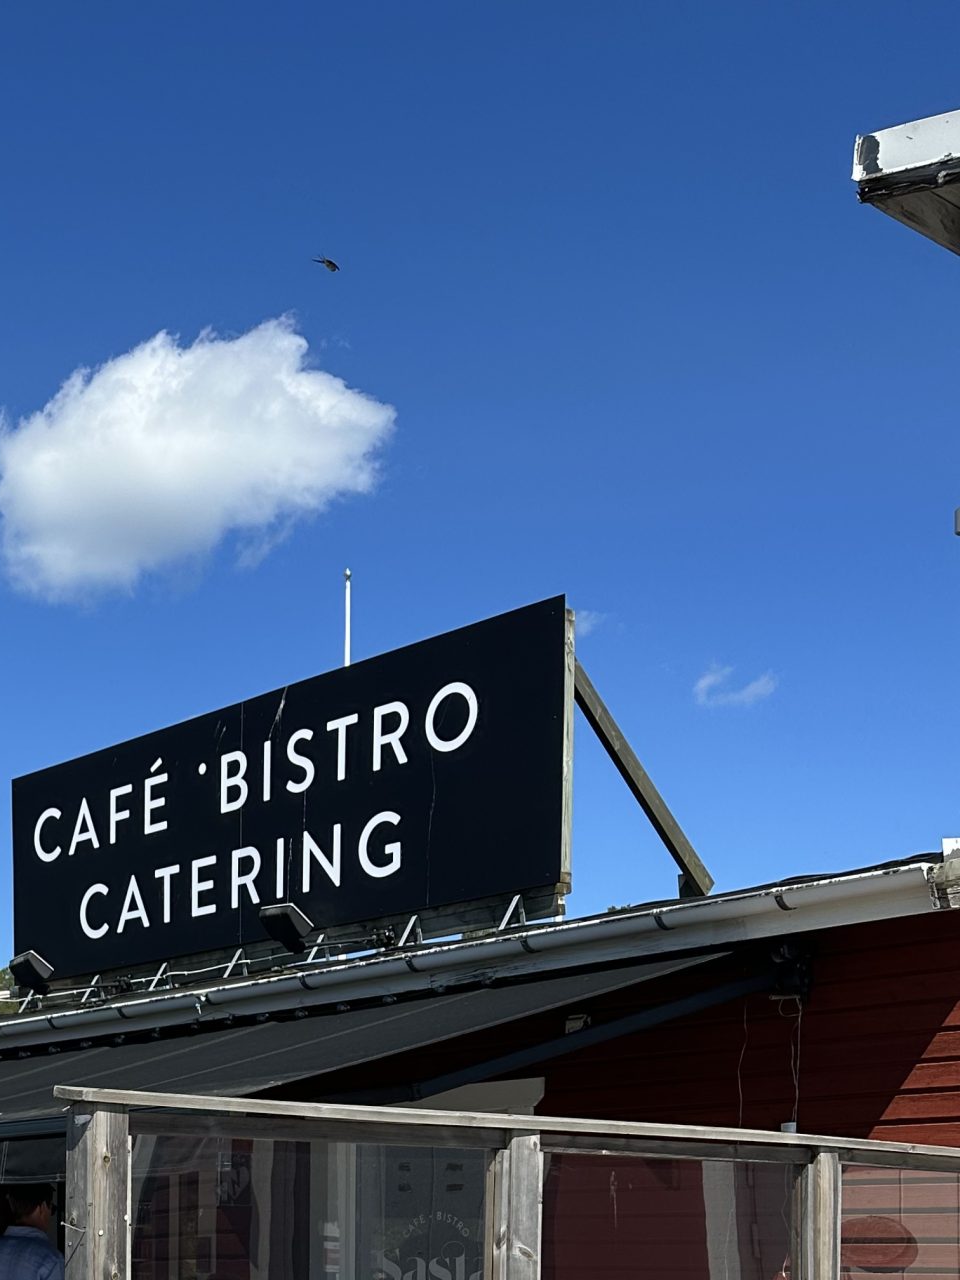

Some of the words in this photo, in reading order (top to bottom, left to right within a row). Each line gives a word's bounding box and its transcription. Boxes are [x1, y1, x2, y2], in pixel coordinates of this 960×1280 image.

[33, 757, 168, 863] CAFÉ
[220, 682, 479, 814] BISTRO
[79, 811, 402, 940] CATERING
[436, 1211, 470, 1238] BISTRO
